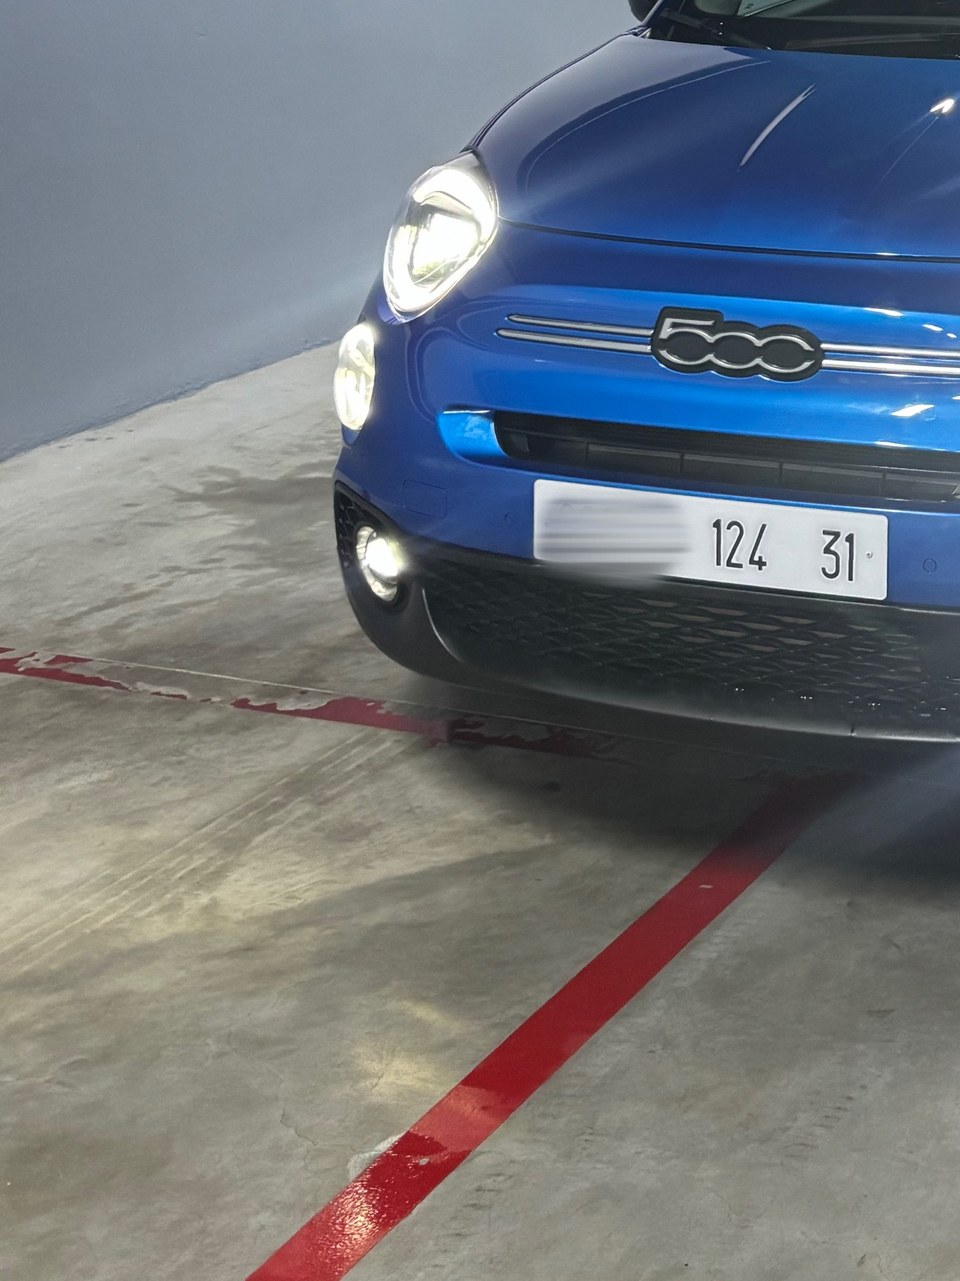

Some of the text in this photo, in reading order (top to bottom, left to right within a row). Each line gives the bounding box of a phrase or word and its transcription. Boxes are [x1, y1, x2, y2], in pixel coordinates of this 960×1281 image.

[654, 310, 820, 380] 500
[712, 518, 768, 571] 124
[820, 529, 855, 582] 31
